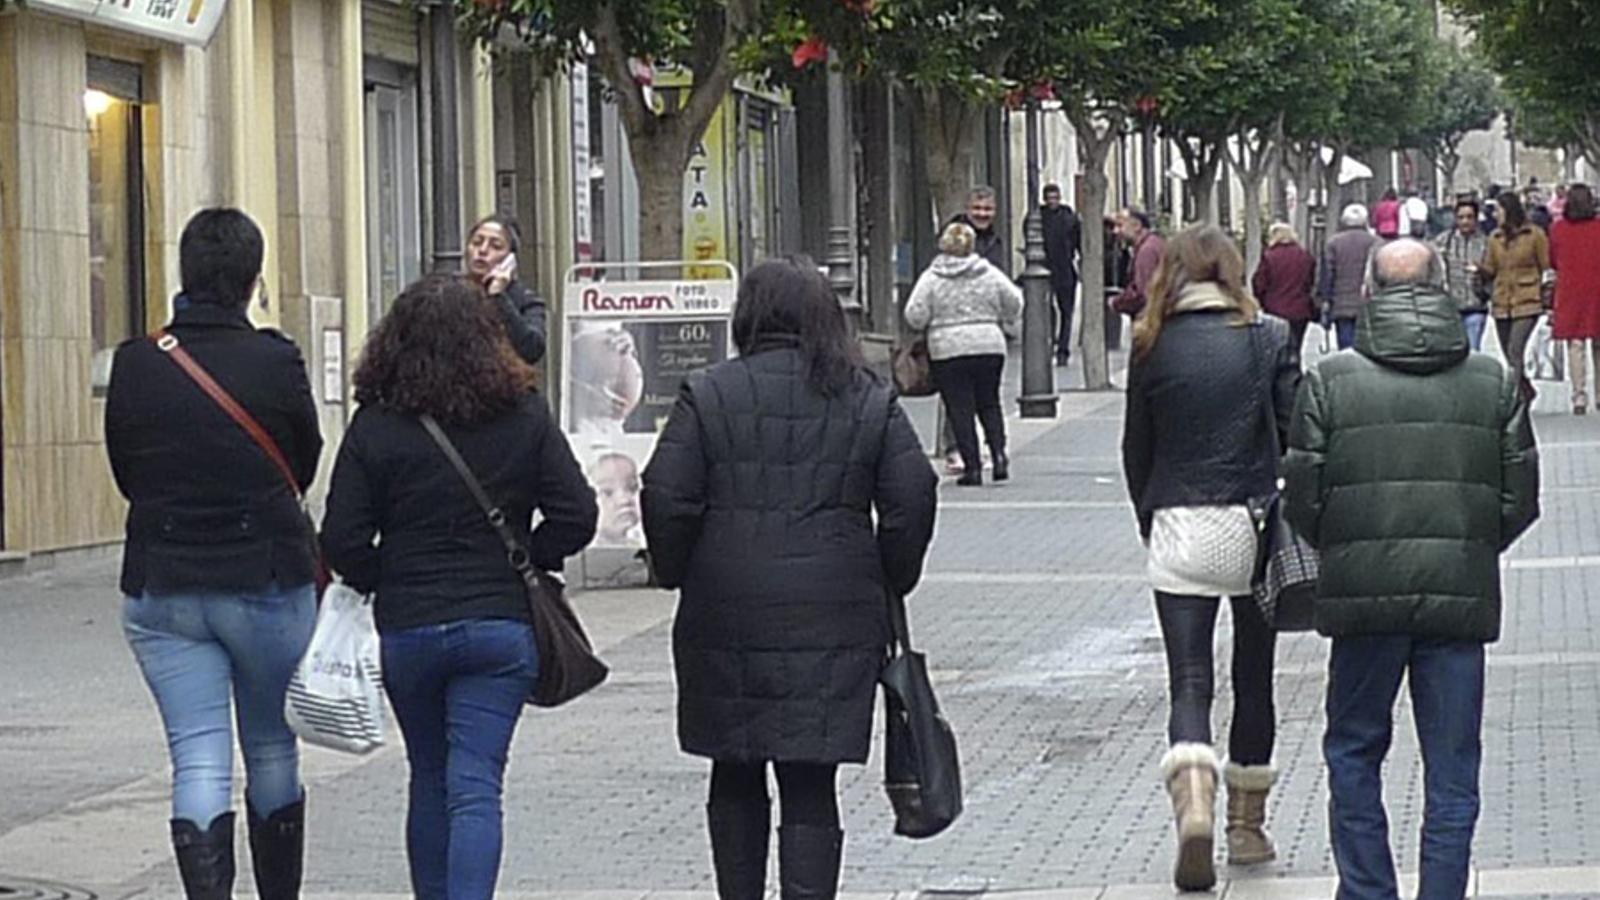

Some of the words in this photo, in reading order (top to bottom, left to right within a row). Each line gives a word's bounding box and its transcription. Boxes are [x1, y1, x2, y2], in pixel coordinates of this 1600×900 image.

[583, 288, 674, 311] Ramon
[676, 285, 706, 297] FOTO
[684, 298, 719, 310] VIDEO
